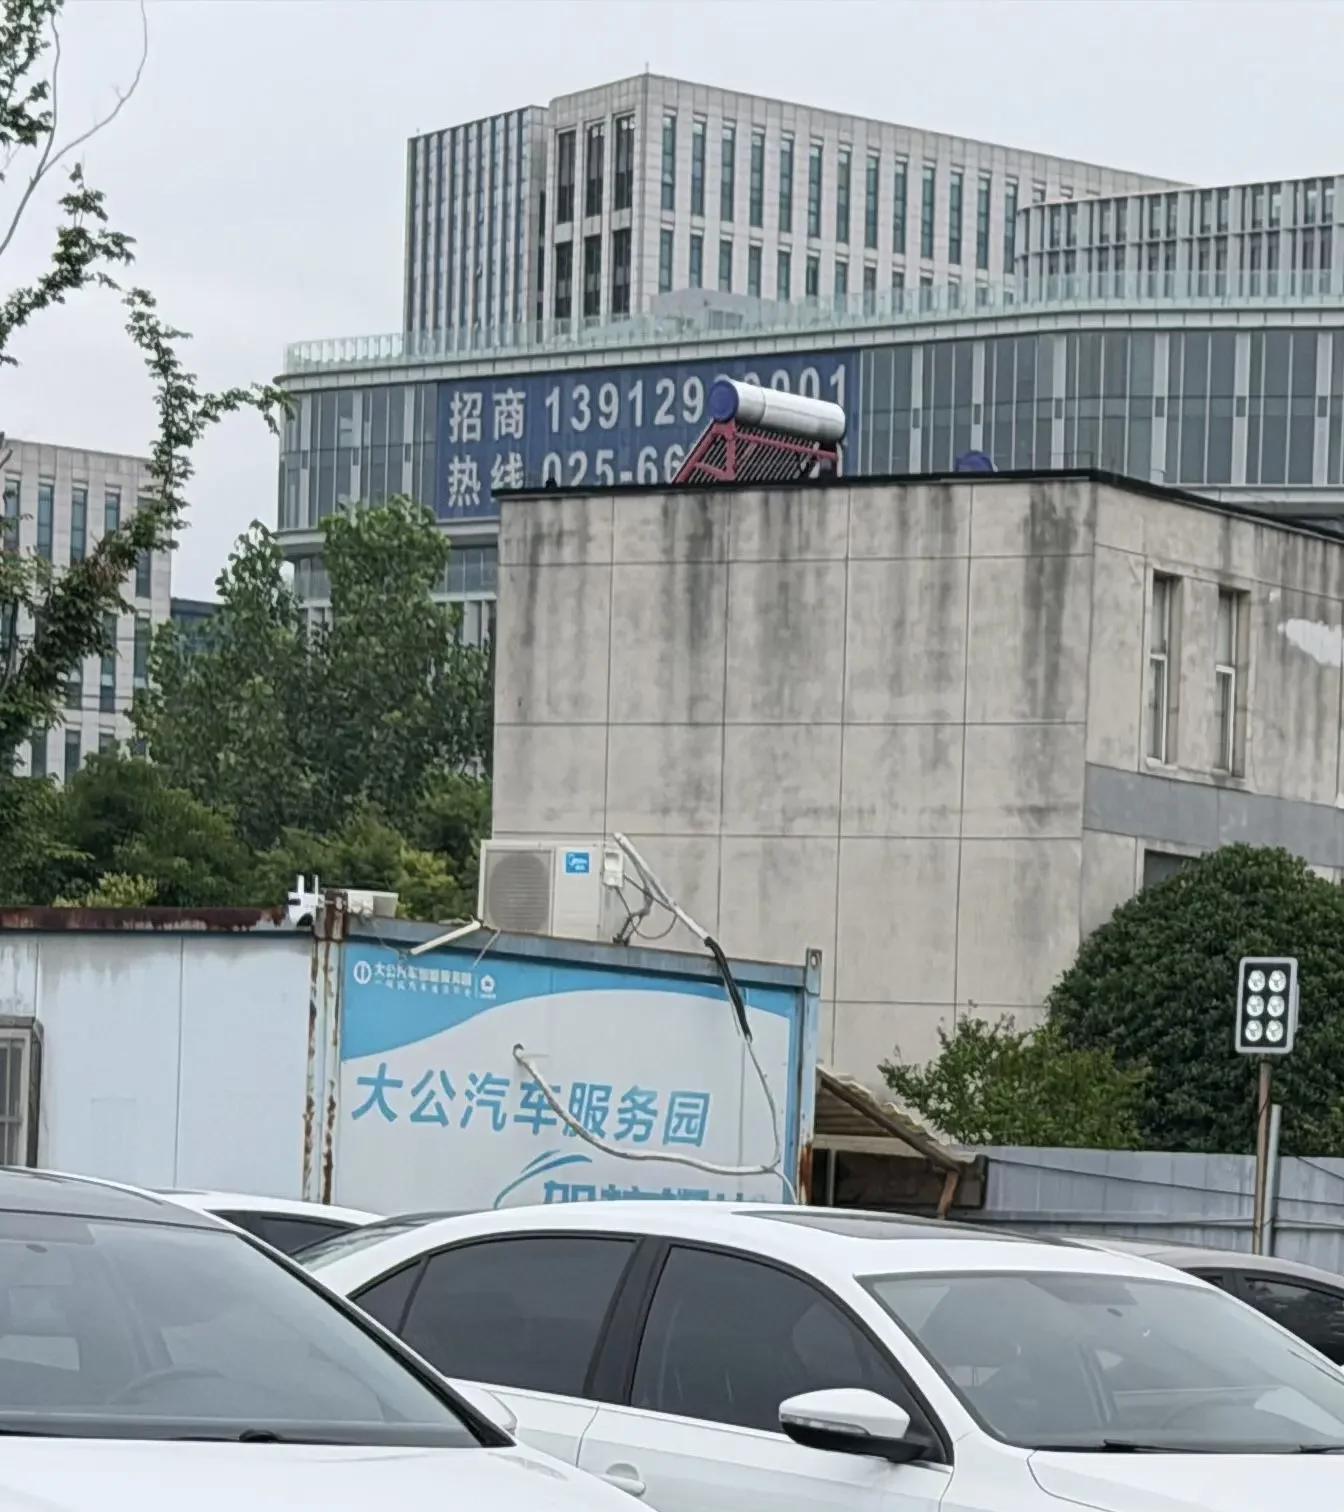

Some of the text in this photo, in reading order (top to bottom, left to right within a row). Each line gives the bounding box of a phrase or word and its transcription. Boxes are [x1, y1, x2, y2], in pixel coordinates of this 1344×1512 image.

[449, 364, 846, 444] 招商 13912901
[447, 451, 524, 507] 热线
[351, 1062, 711, 1148] 大公汽车服务园
